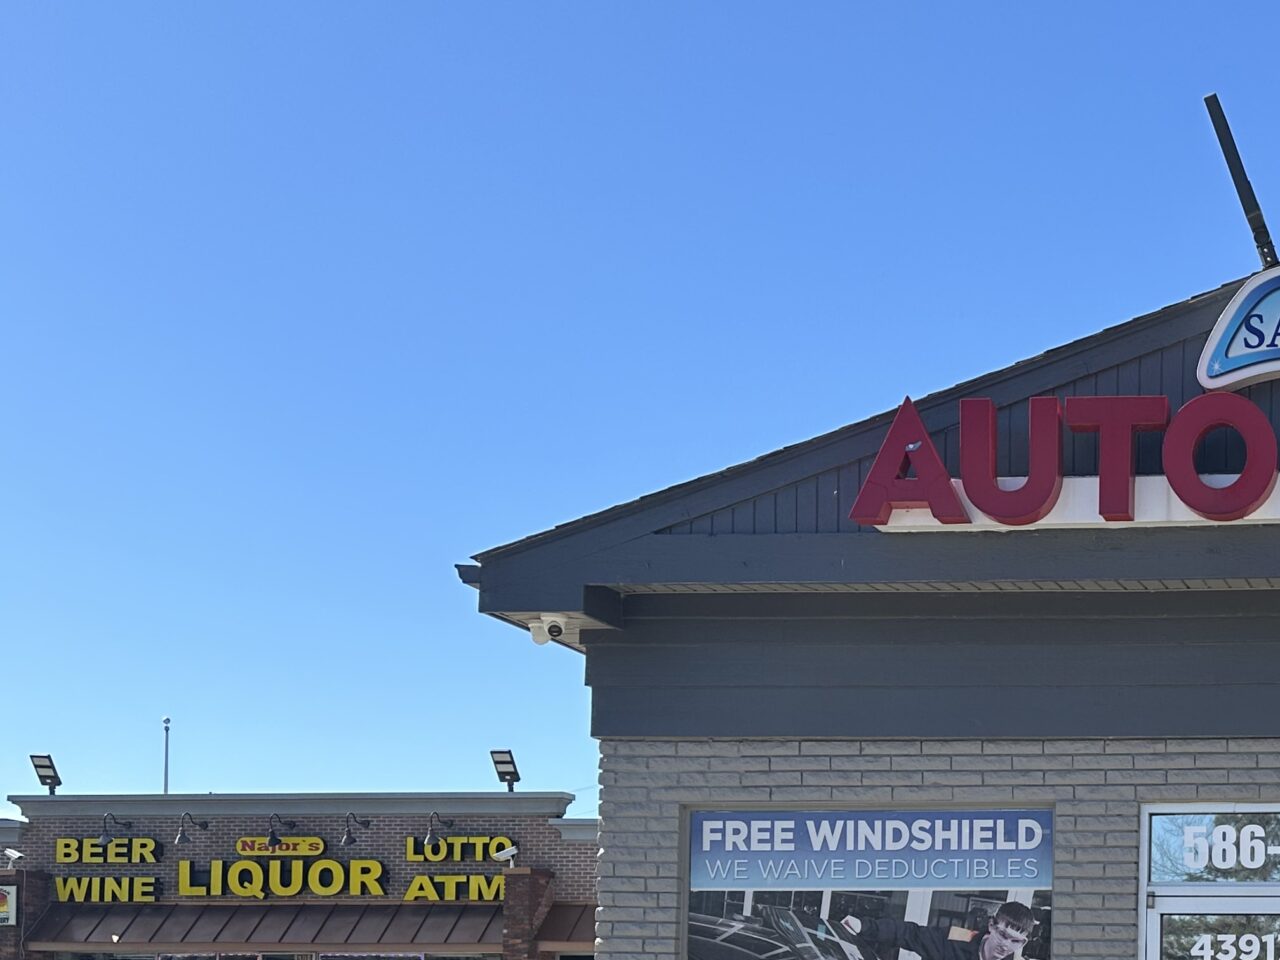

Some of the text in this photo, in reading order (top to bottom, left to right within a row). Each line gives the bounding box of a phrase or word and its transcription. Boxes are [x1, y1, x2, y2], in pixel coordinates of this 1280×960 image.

[848, 394, 1279, 527] AUTO
[702, 818, 1044, 852] FREE WINDSHIELD
[55, 837, 157, 864] BEER
[405, 836, 512, 863] LOTTO
[178, 859, 386, 900] LIQUOR
[704, 857, 1040, 880] WE WAIVE DEDUCTIBLES
[55, 876, 156, 903] WINE
[403, 875, 506, 901] ATM
